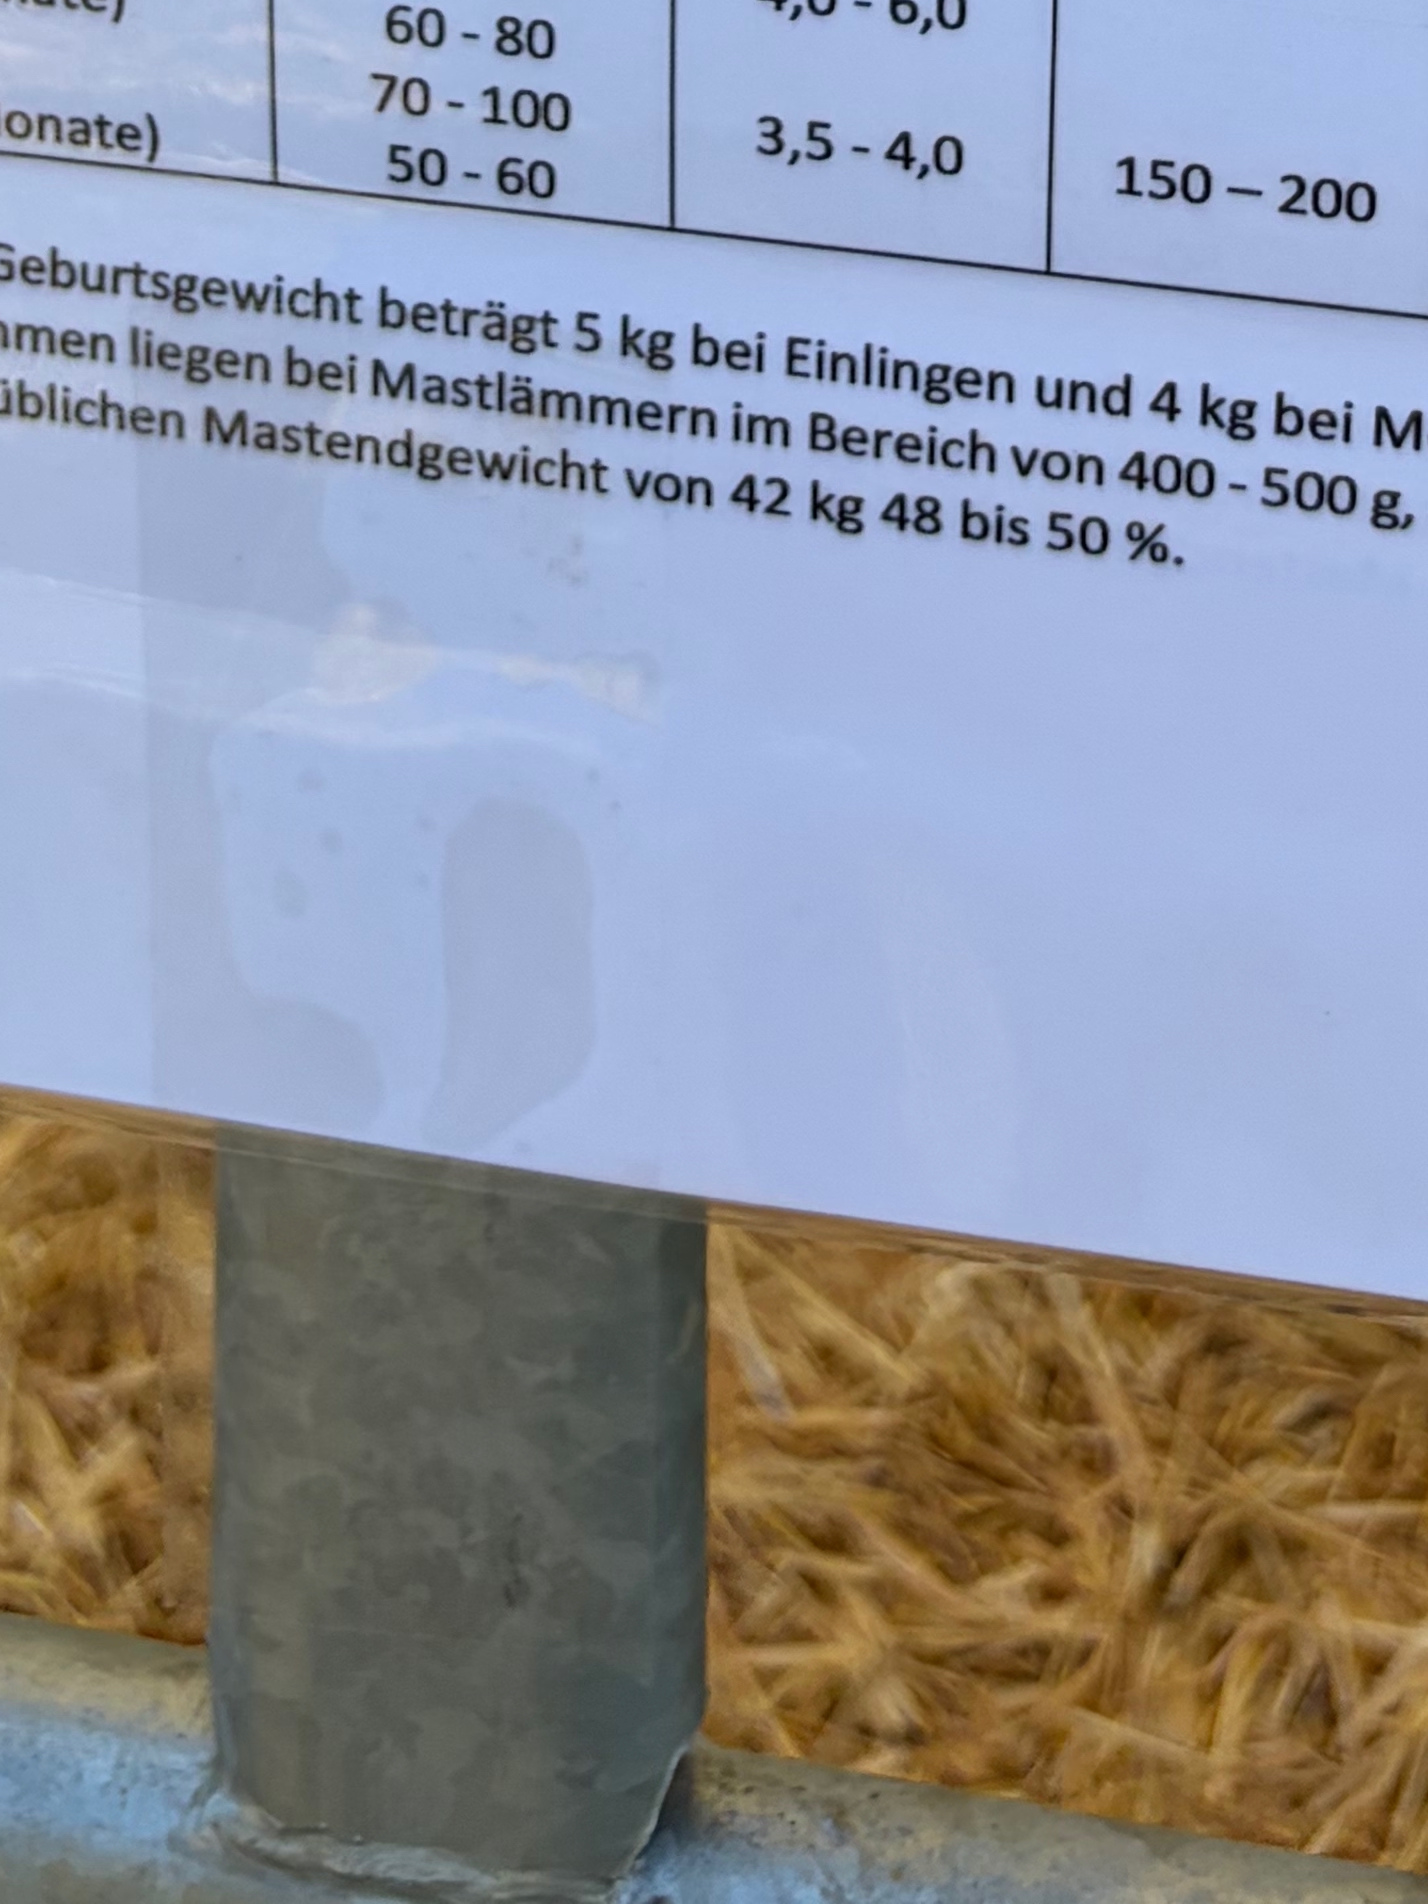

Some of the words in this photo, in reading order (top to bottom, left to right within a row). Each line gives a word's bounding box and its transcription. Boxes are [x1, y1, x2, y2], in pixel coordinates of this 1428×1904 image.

[1115, 155, 1213, 205] 150
[1277, 173, 1378, 224] 200
[203, 405, 610, 495] Mastendgewicht
[624, 467, 714, 509] von
[729, 473, 792, 518] 42
[809, 479, 866, 536] kg
[879, 492, 944, 536] 48
[960, 497, 1031, 548] bis
[1045, 511, 1111, 557] 50
[1124, 520, 1185, 568] %.
